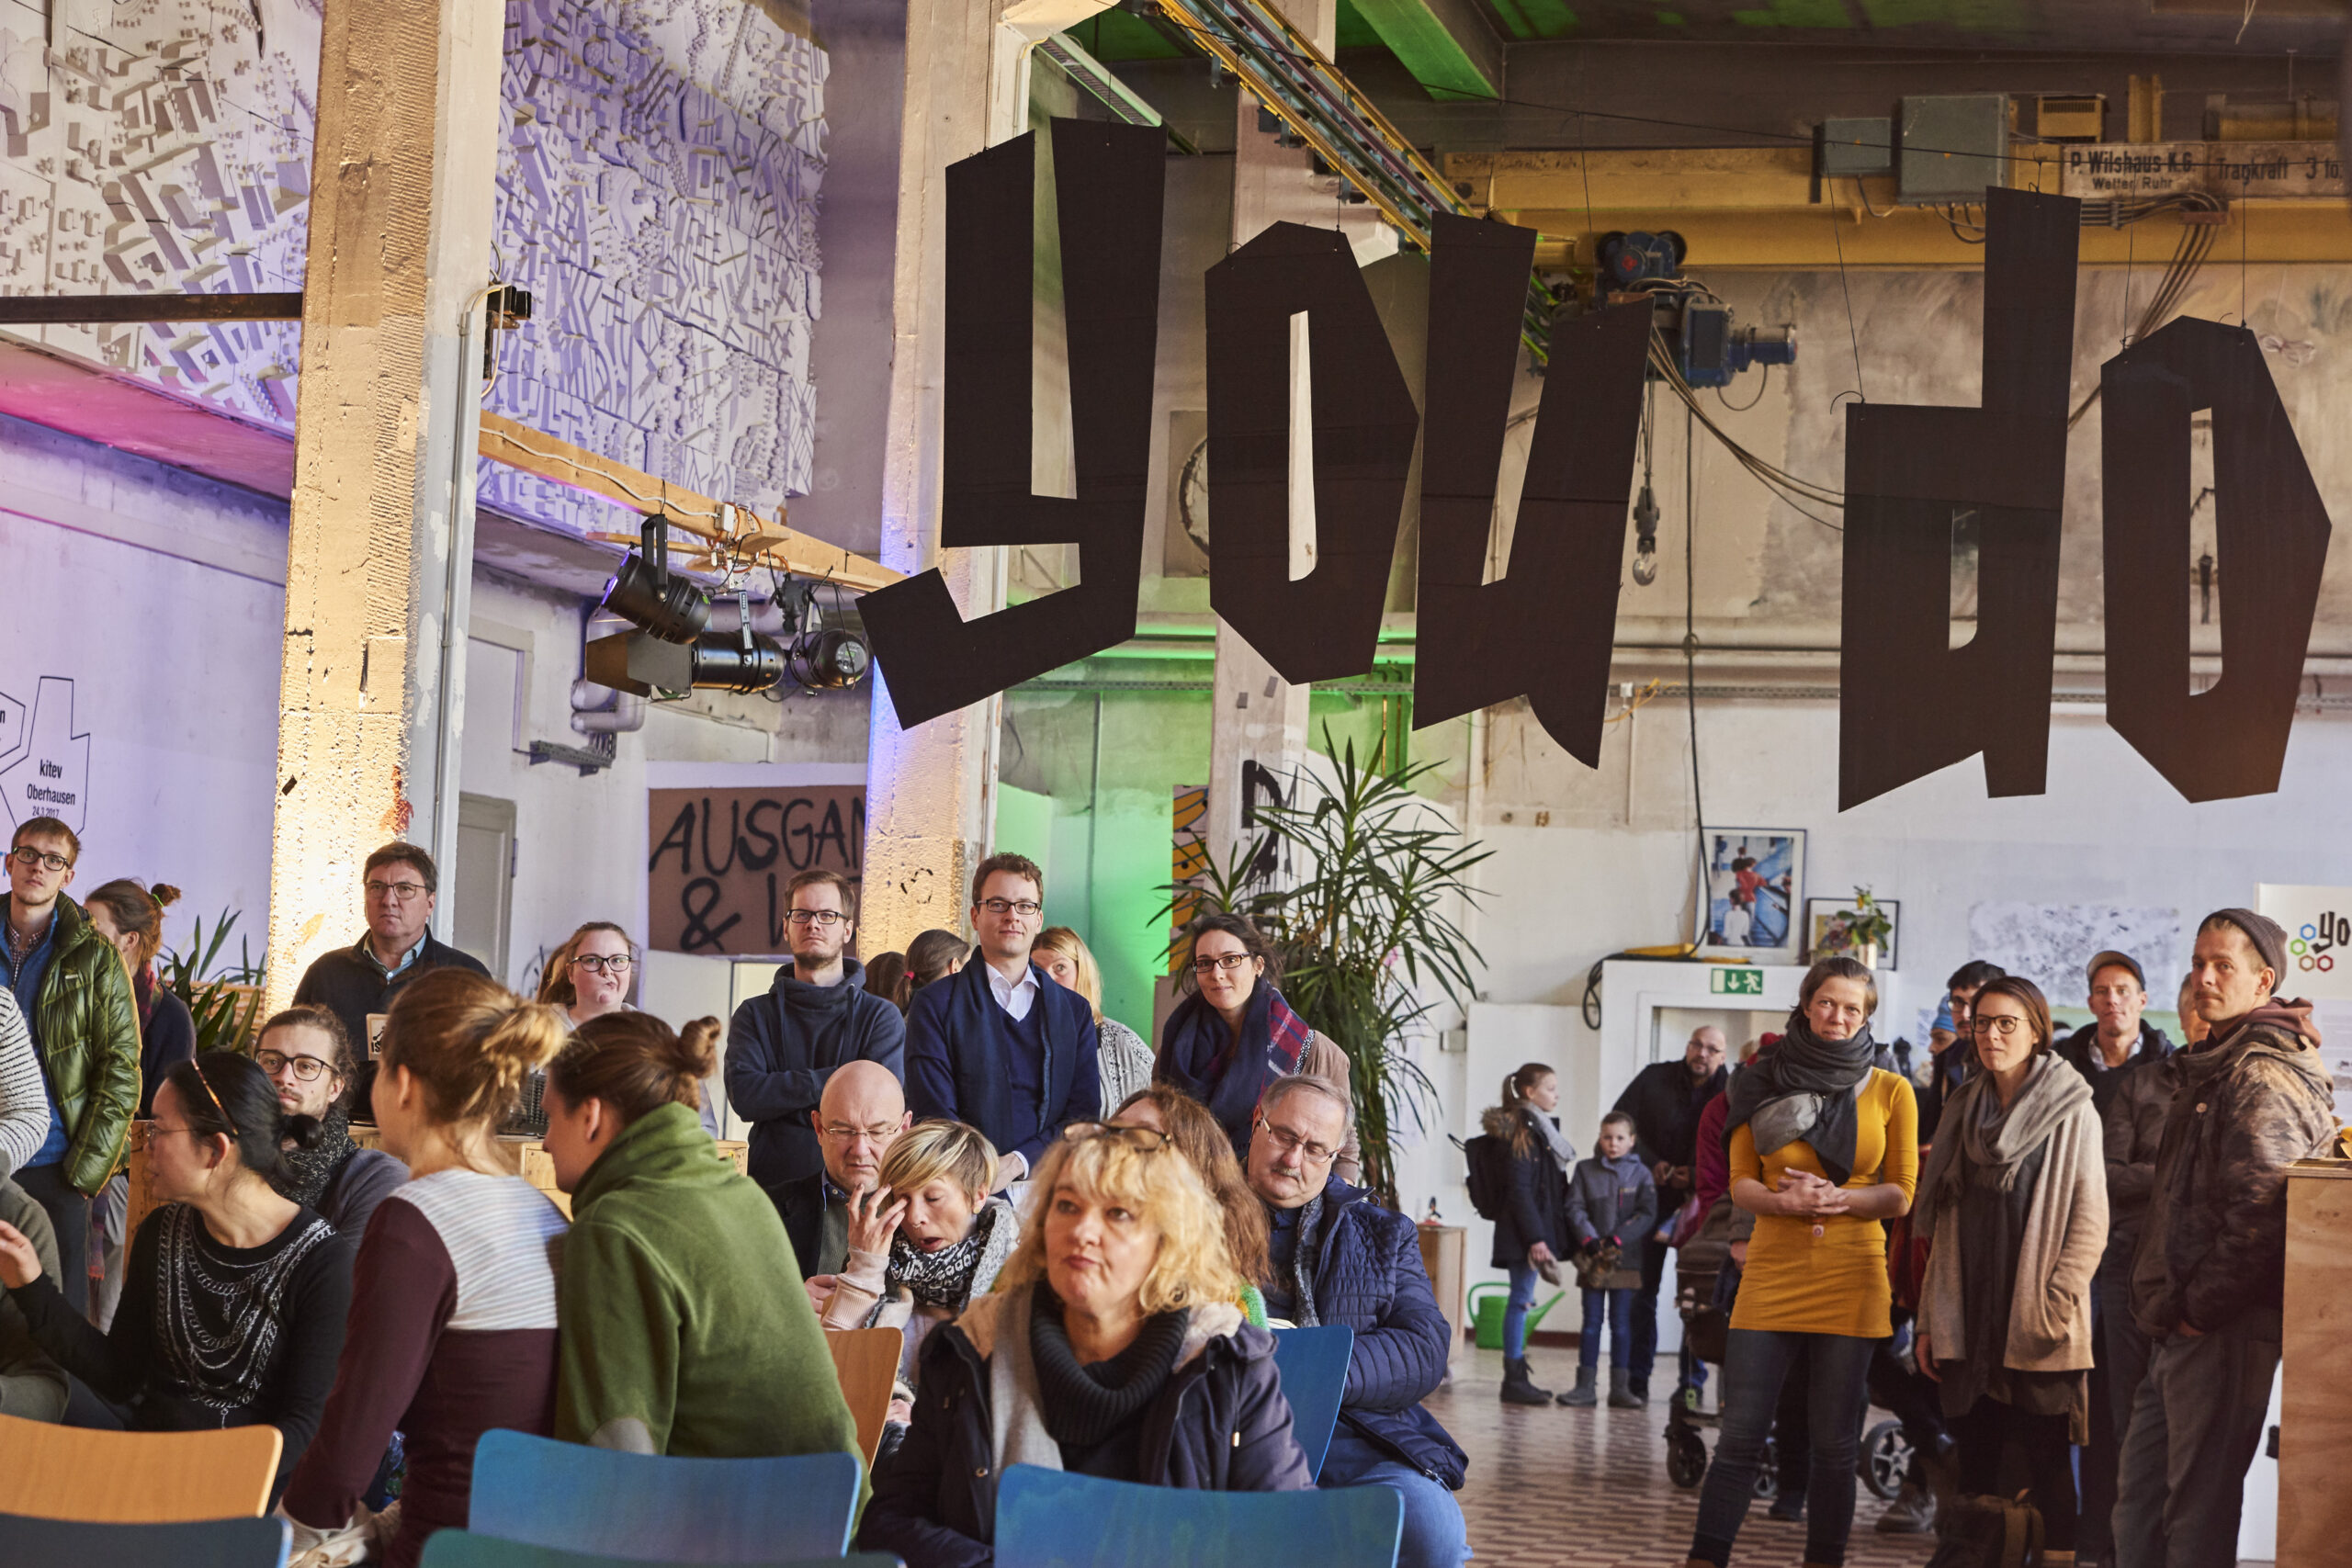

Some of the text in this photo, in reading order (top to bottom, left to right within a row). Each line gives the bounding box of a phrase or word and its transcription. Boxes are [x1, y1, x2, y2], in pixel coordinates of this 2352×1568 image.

[2216, 156, 2289, 185] Tragkraft
[2305, 156, 2317, 180] 3
[40, 759, 62, 779] kitev
[27, 784, 75, 805] Oberhausen
[680, 876, 741, 953] &
